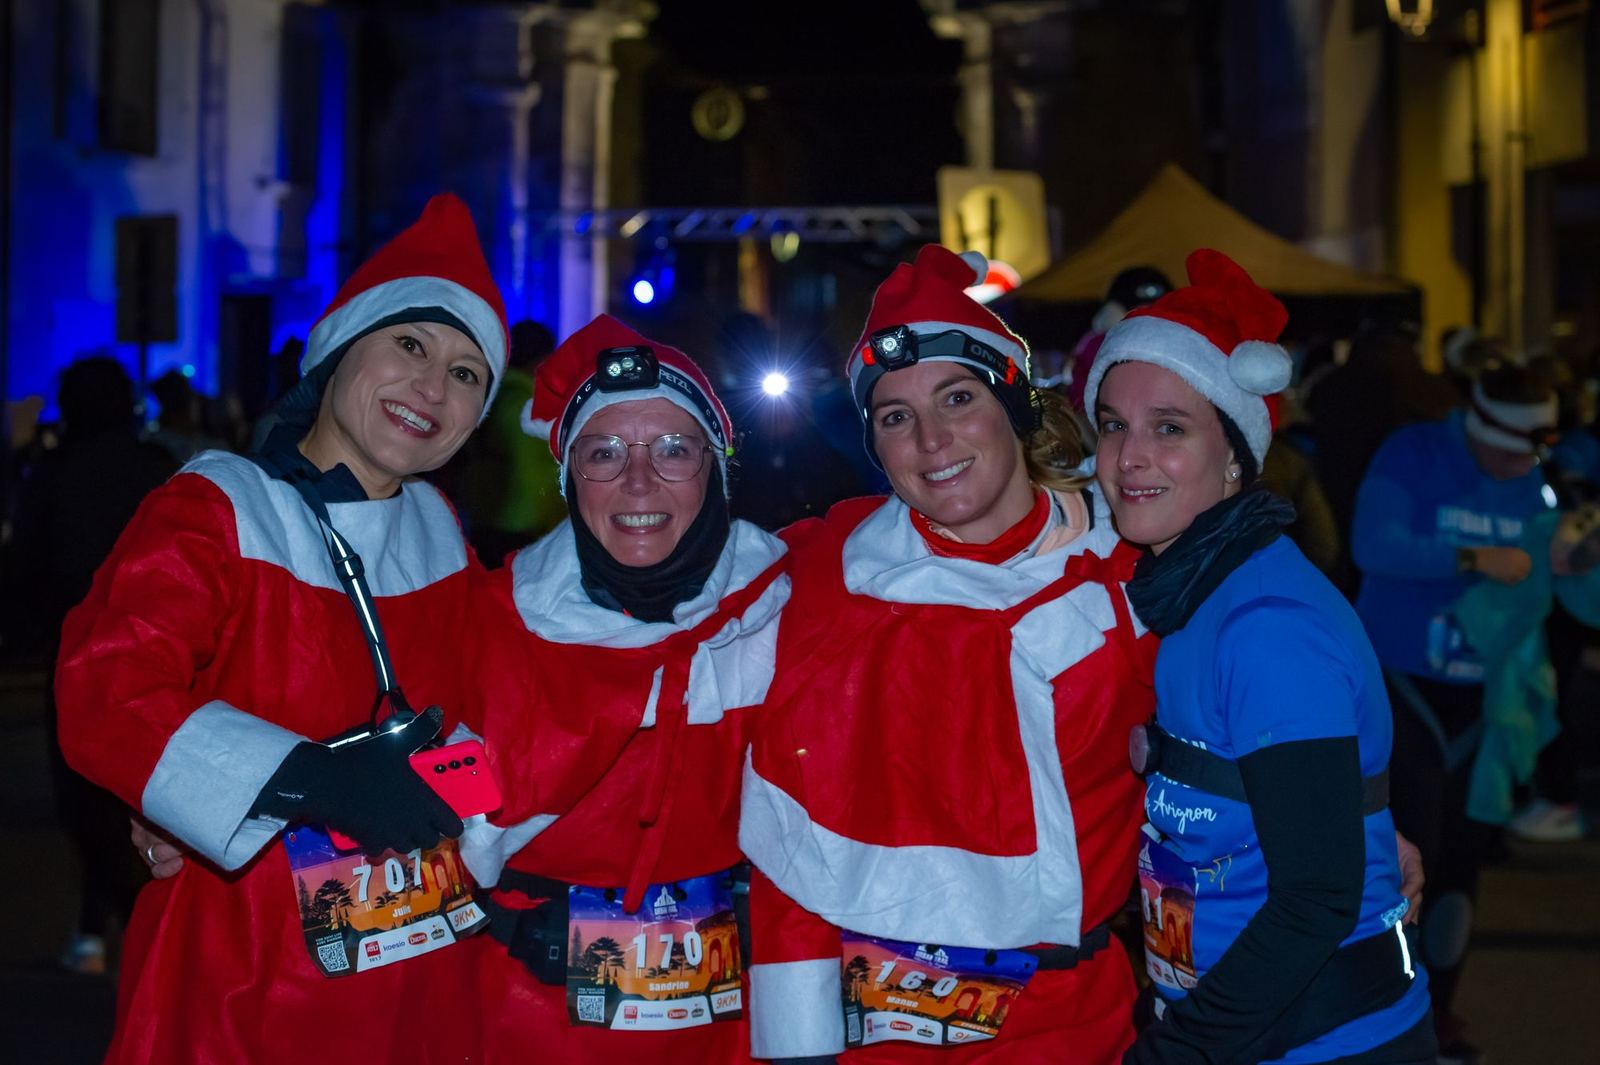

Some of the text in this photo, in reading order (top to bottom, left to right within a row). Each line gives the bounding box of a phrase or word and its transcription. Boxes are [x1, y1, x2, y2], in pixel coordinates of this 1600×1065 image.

[659, 369, 692, 394] PETZL
[1152, 788, 1218, 835] Avignon
[352, 848, 422, 902] 707
[454, 908, 477, 927] 9KM
[383, 940, 406, 952] koesio
[632, 931, 703, 969] 170
[914, 950, 934, 962] URBAN
[649, 980, 689, 992] Sandrine
[875, 960, 960, 998] 160
[716, 994, 738, 1009] 9KM
